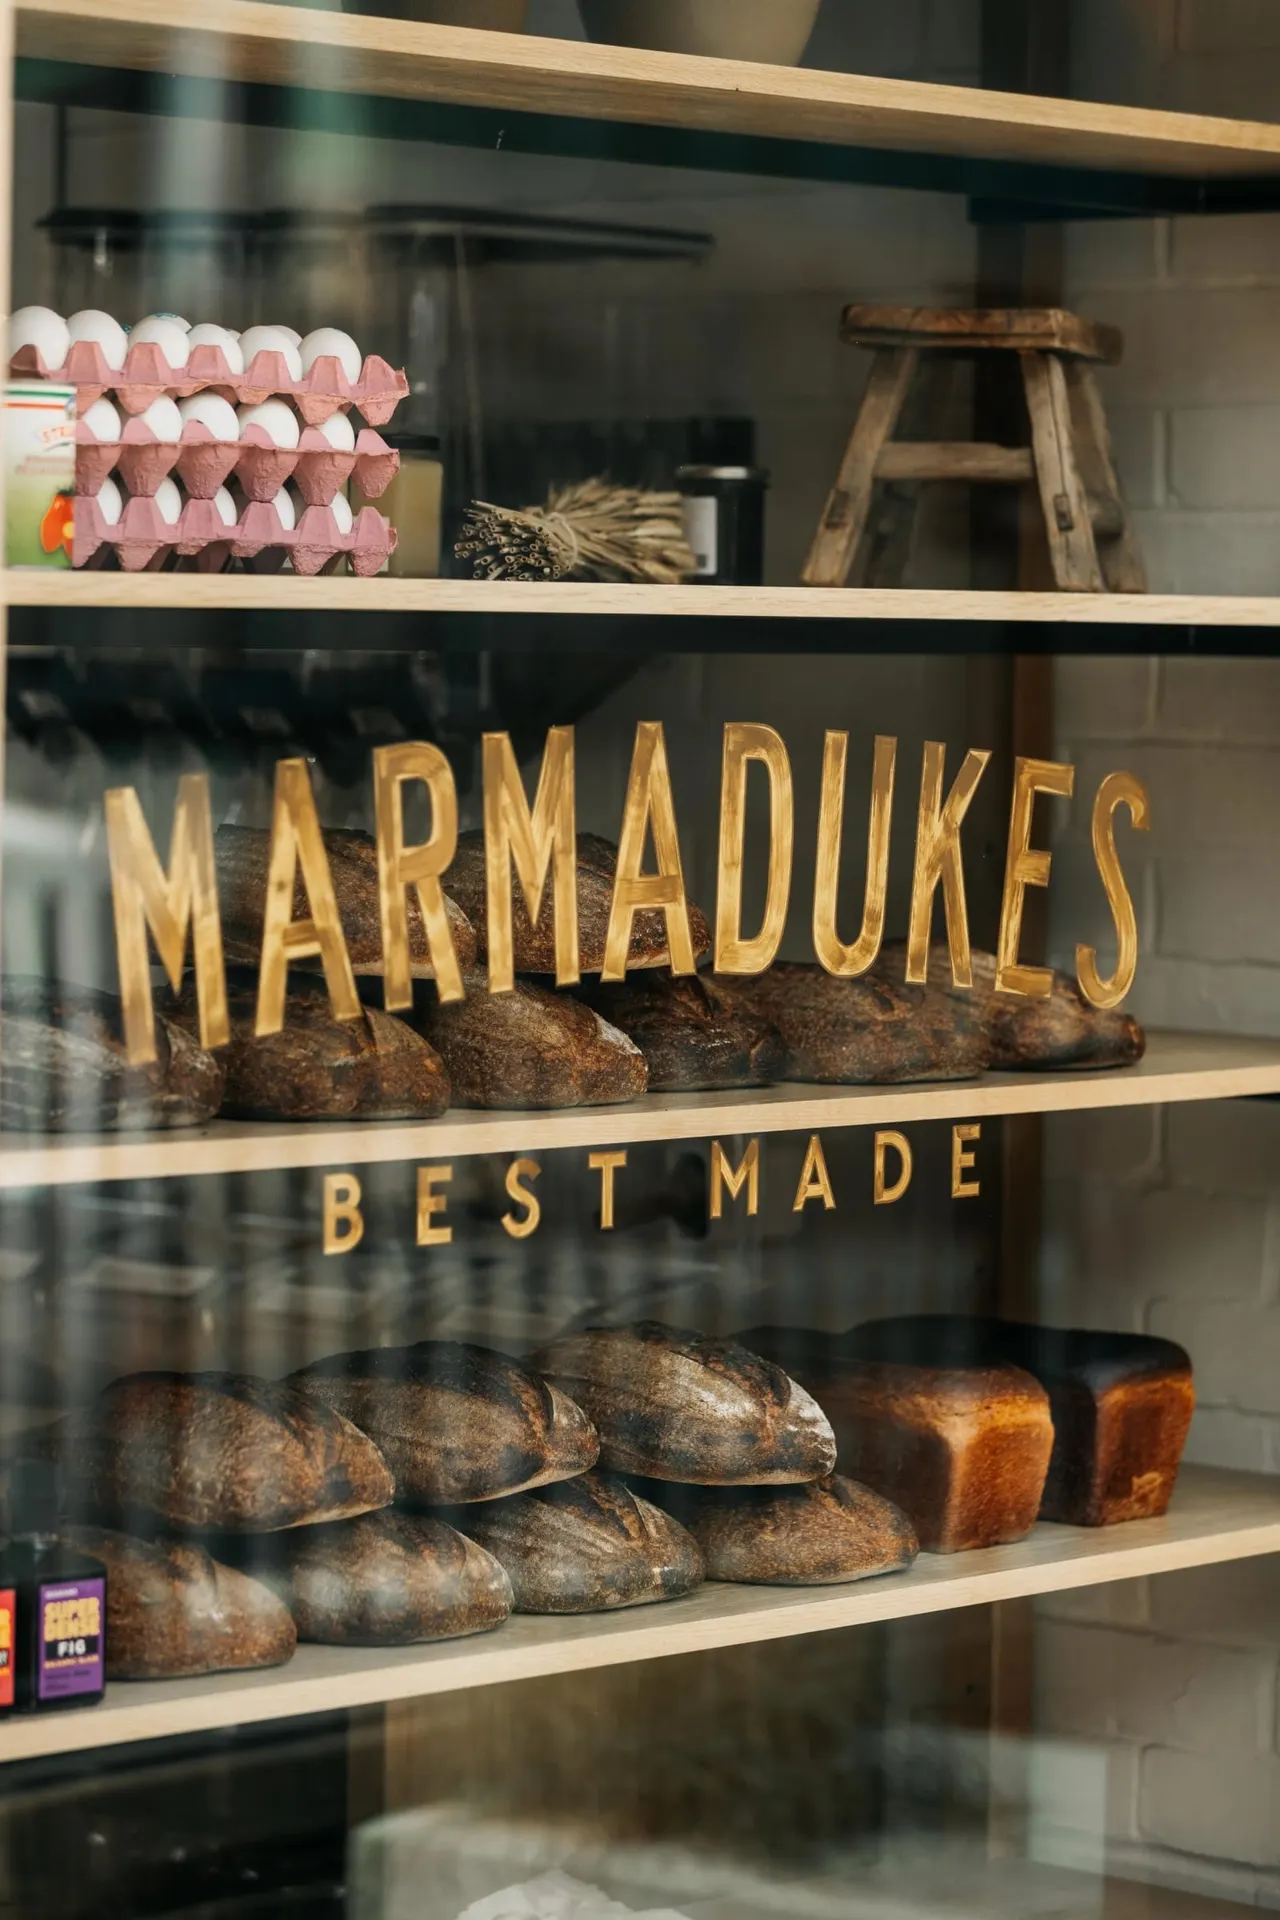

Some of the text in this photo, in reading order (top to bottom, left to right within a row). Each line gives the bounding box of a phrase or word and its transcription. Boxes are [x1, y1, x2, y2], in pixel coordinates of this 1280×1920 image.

[104, 721, 1150, 1066] MARMADUKES
[322, 1123, 982, 1256] BEST MADE
[57, 1639, 86, 1658] FIG
